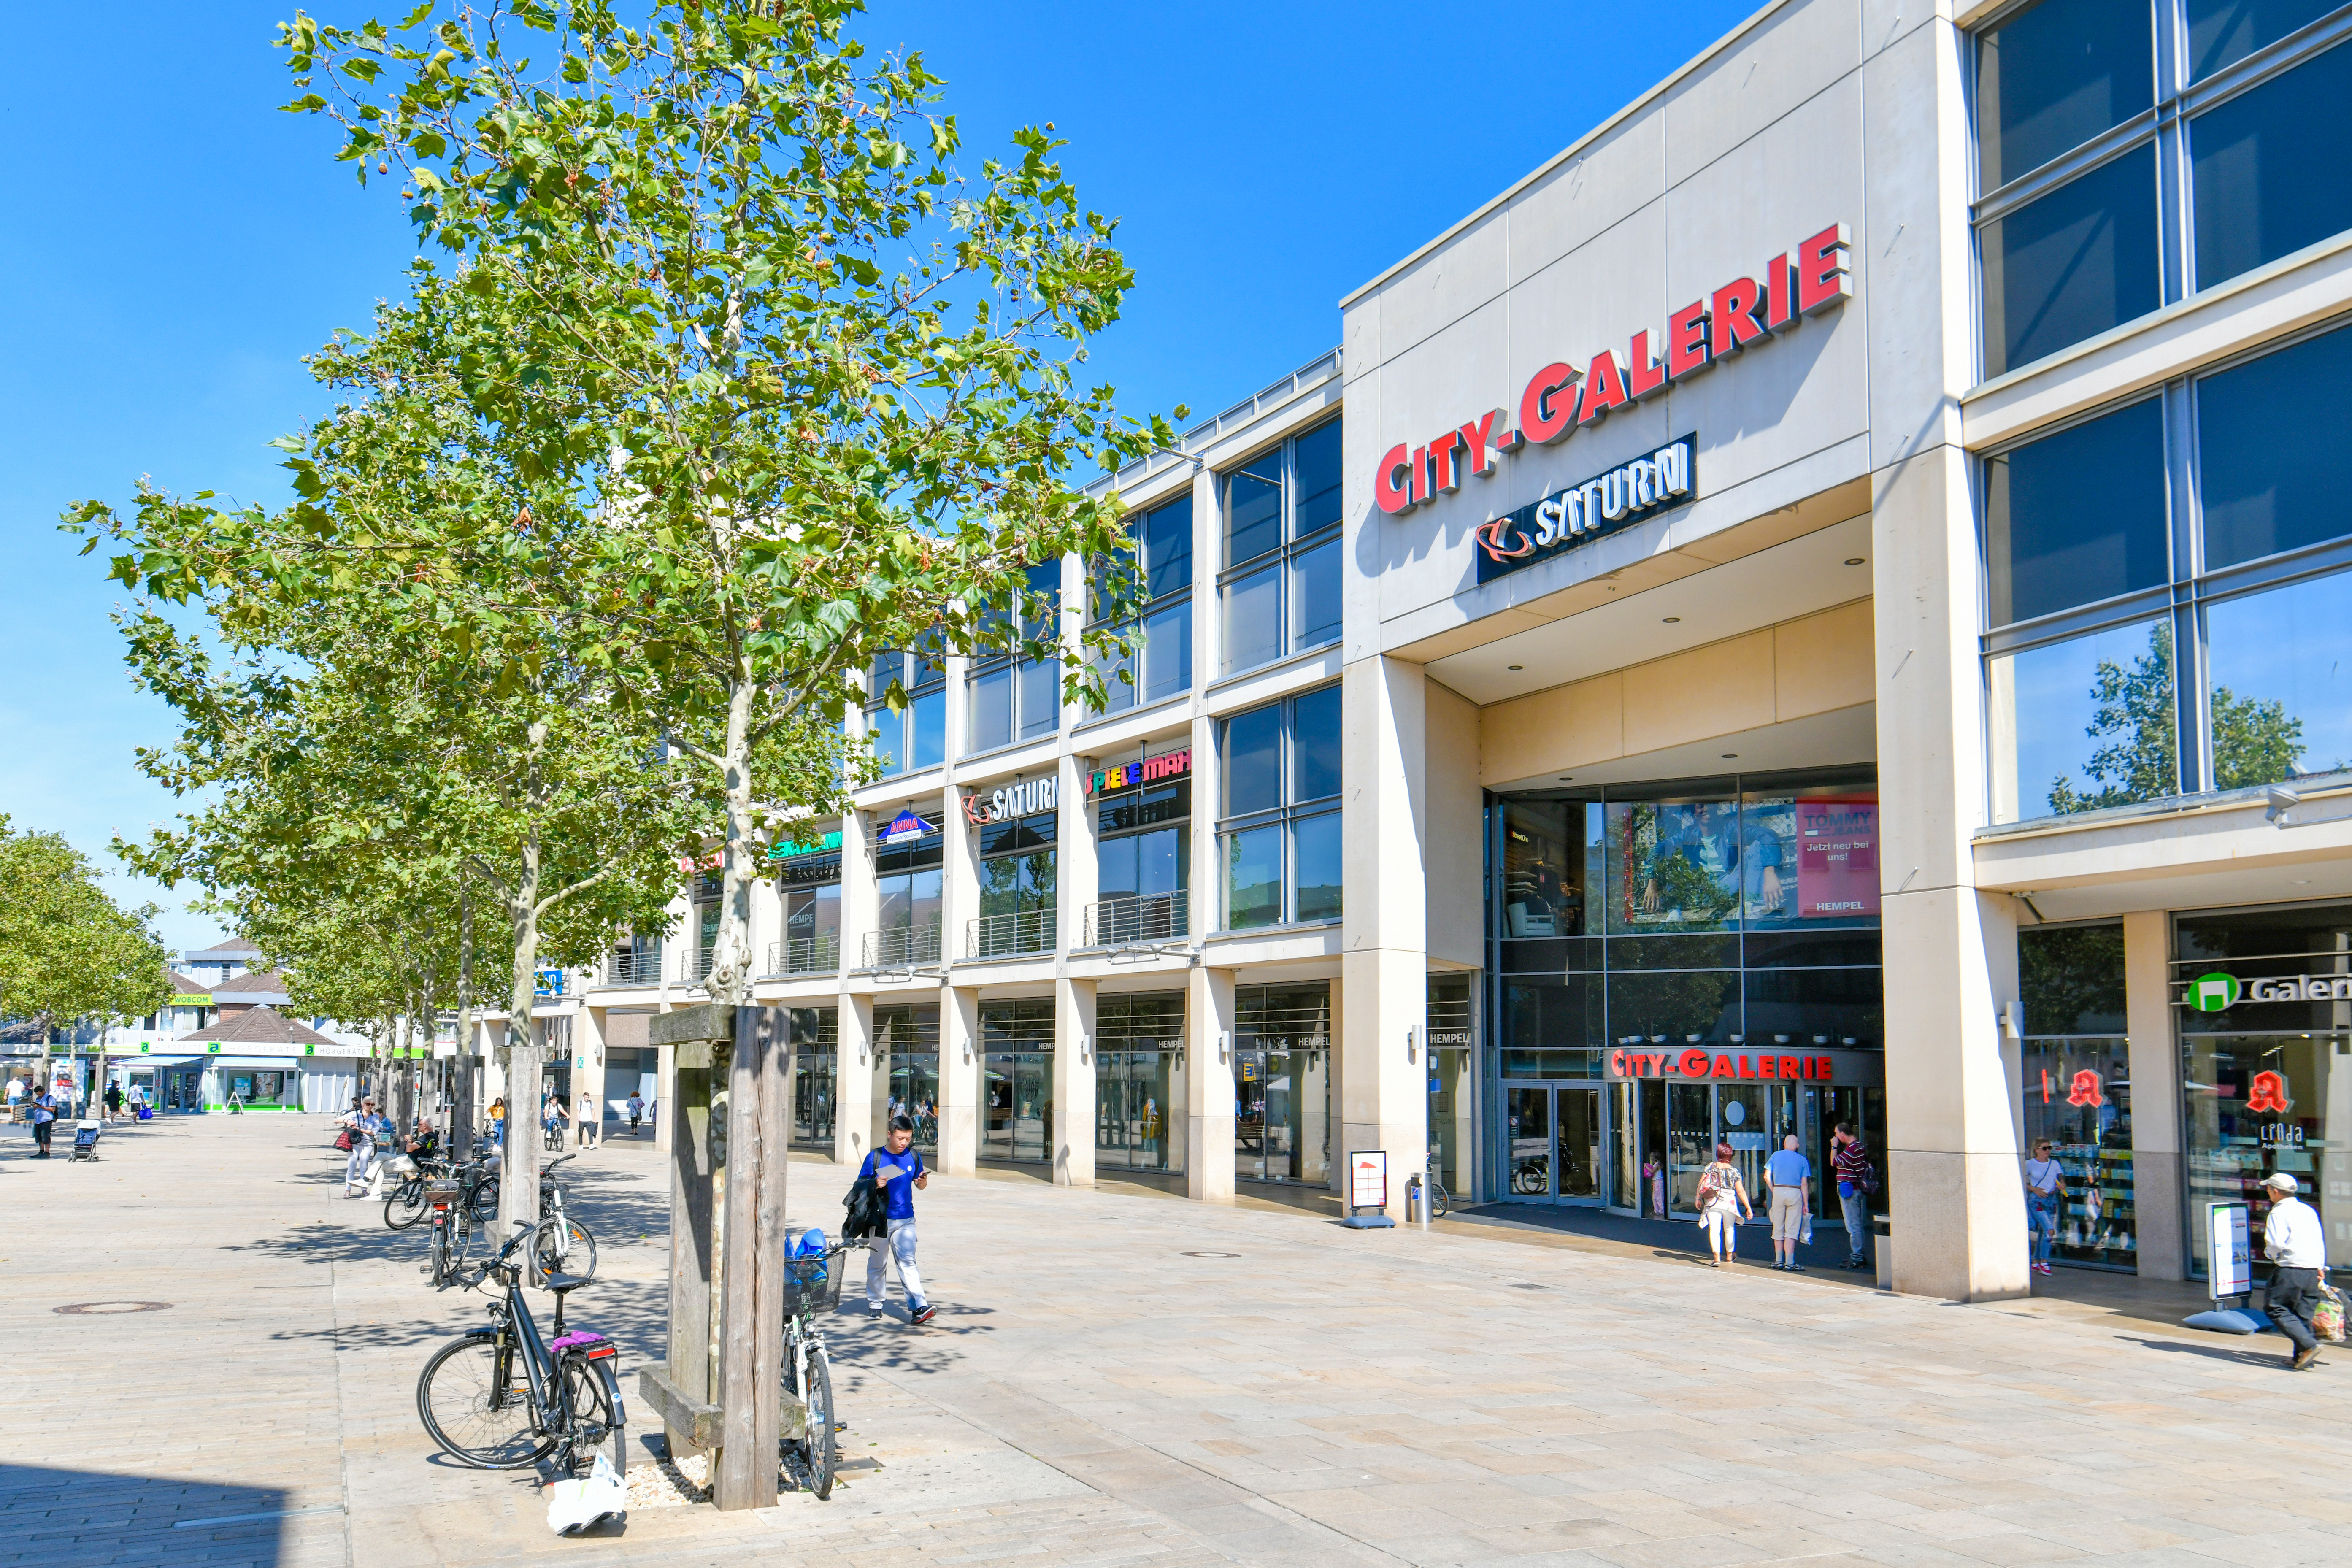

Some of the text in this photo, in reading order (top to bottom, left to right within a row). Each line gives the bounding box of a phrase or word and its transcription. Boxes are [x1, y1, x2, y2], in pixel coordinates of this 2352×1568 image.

[1536, 442, 1689, 548] SATURN
[1085, 749, 1191, 794] SPIELE MAX
[1805, 811, 1871, 827] TOMMY
[890, 817, 918, 834] ANNA
[1833, 825, 1871, 835] JEANS
[1512, 831, 1522, 841] Street
[1807, 843, 1831, 852] Jetzt
[1854, 841, 1869, 849] bei
[1828, 853, 1848, 861] uns!
[1816, 901, 1865, 911] HEMPEL
[1298, 1037, 1330, 1046] HEMPEL
[1430, 1033, 1468, 1044] HEMPEL
[1158, 1040, 1185, 1048] HEMPEL
[320, 1047, 365, 1055] HÖRGERÄTE
[1611, 1049, 1833, 1080] CITY-GALERIE
[2261, 1142, 2303, 1150] Apotheken
